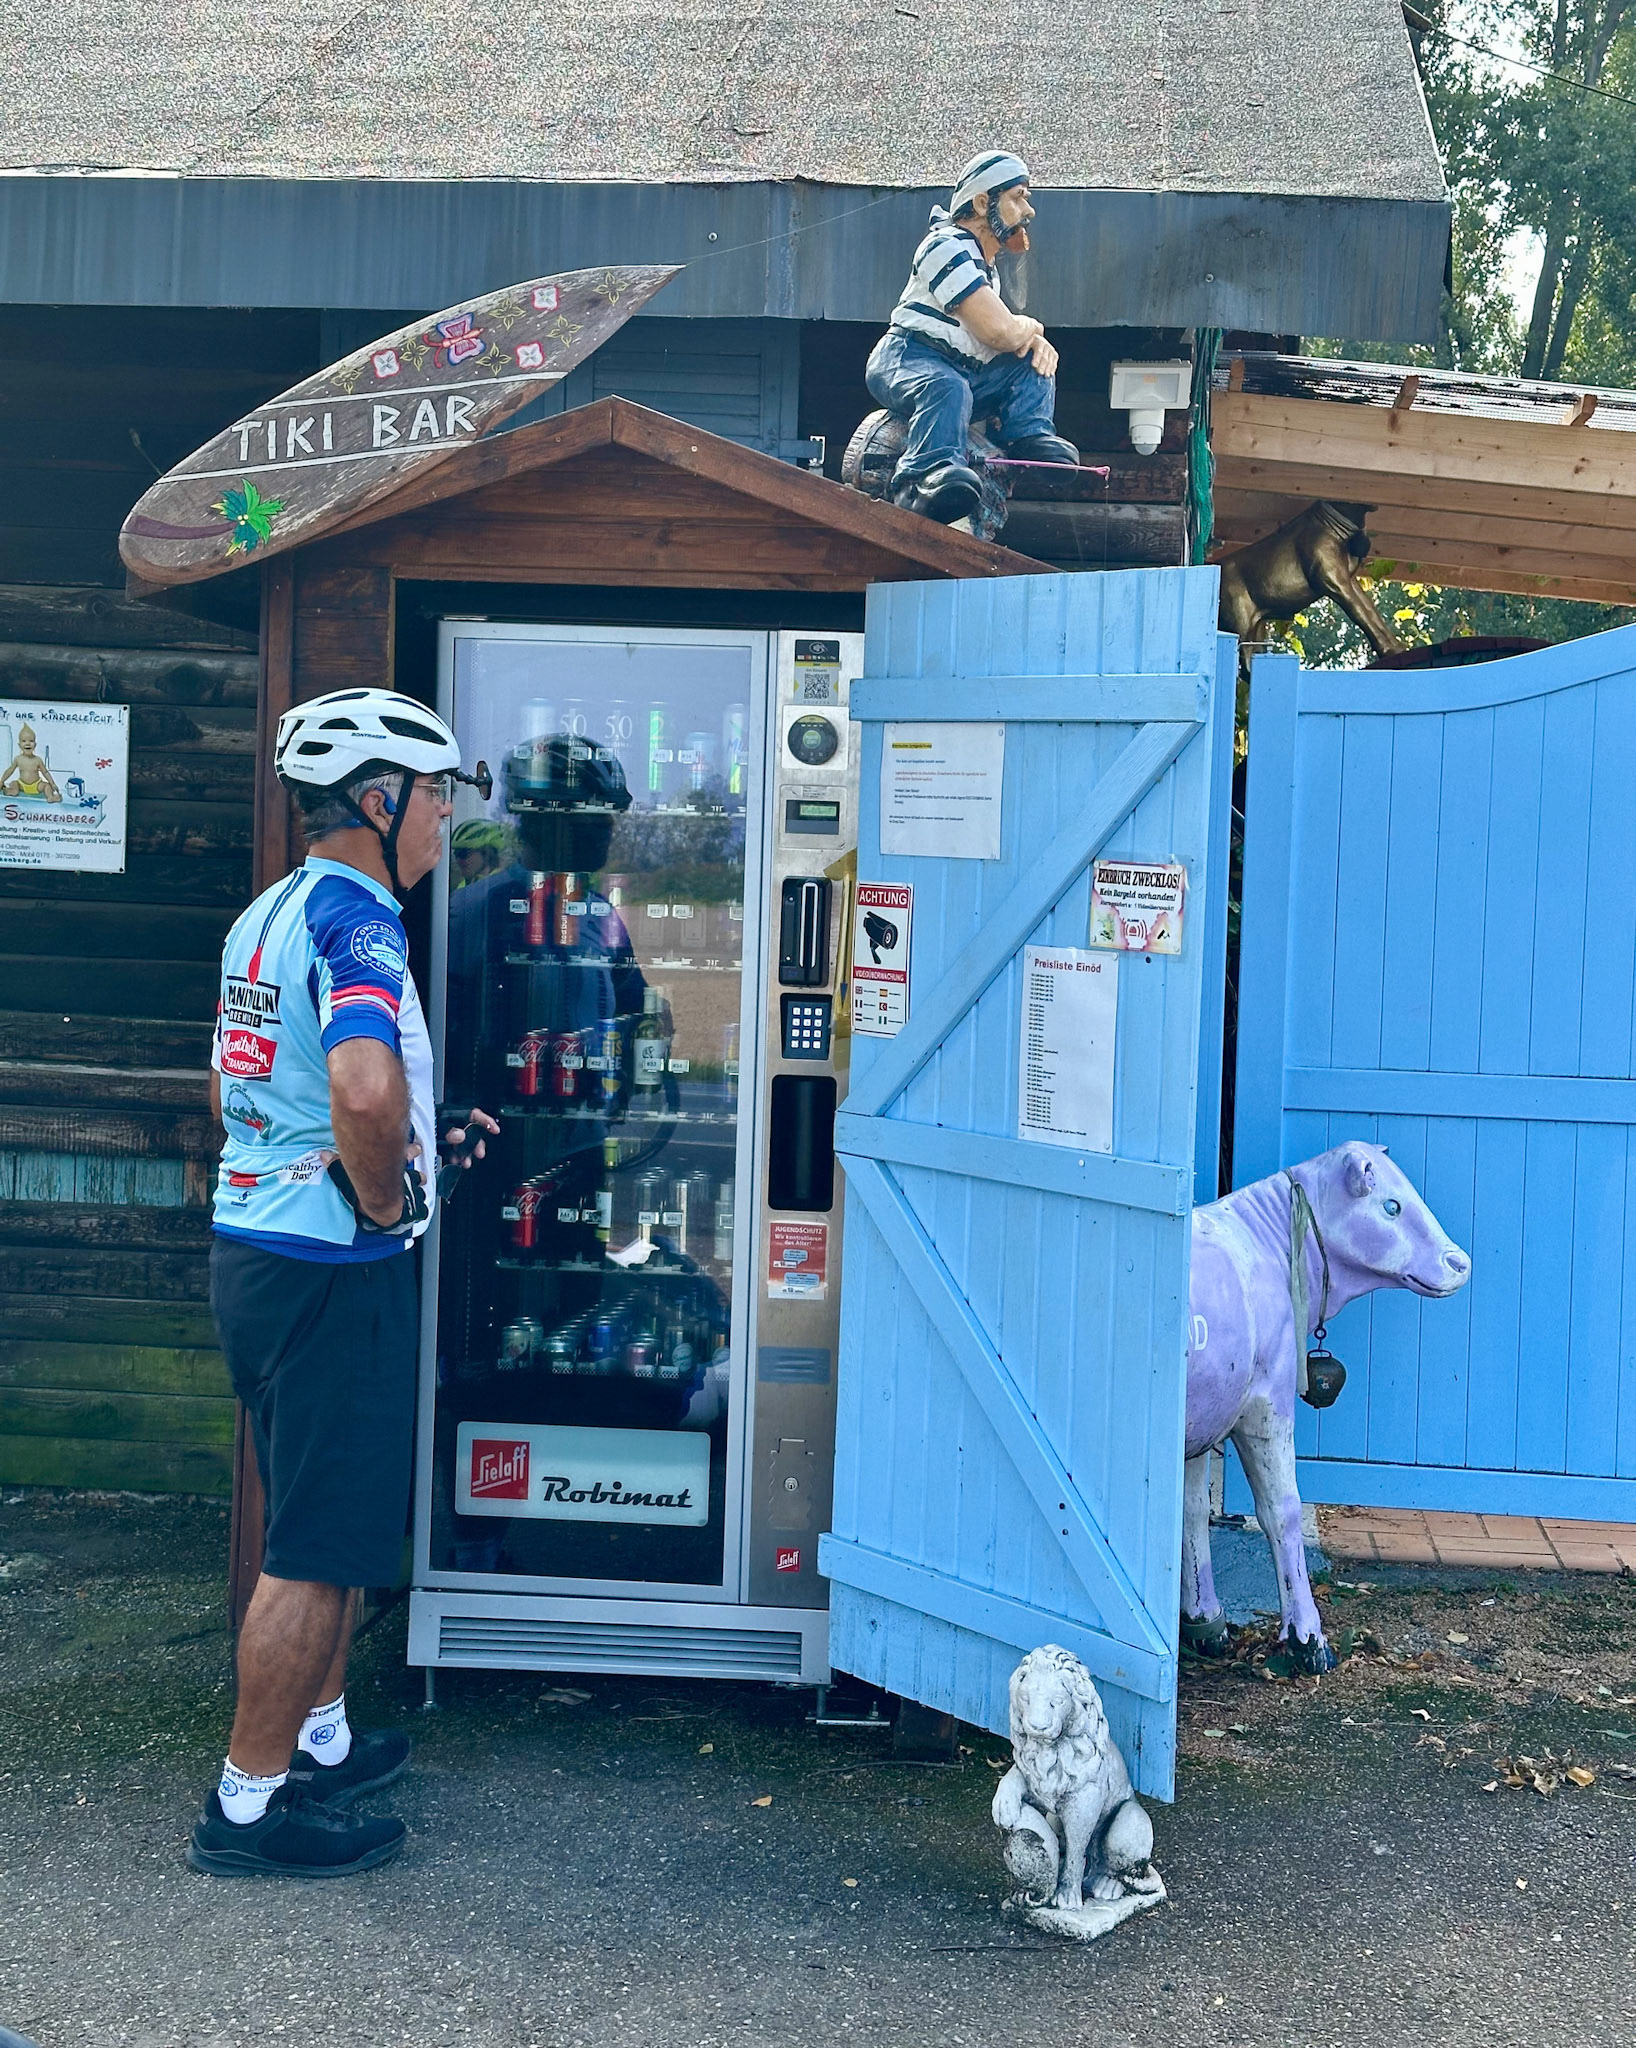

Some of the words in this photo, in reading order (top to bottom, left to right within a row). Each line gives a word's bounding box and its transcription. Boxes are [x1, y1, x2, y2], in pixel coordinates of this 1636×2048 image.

[231, 412, 334, 462] TIKI
[373, 395, 477, 448] BAR
[15, 711, 34, 719] UNS
[4, 804, 96, 826] SCHNAKENBERG
[1097, 868, 1131, 885] EINBRUCH
[1132, 871, 1181, 889] ZWECKLOS!
[859, 890, 908, 905] ACHTUNG
[1099, 888, 1113, 896] Kein
[1113, 889, 1136, 899] Bargeld
[1137, 892, 1177, 901] vorhanden!
[359, 925, 378, 936] OWEN
[1034, 958, 1074, 971] Preisliste
[1076, 961, 1102, 973] Einöd
[855, 969, 905, 981] VIDEOÜBERWACHUNG
[226, 1057, 261, 1073] TRANSPORT
[291, 1171, 312, 1181] Day!
[774, 1226, 823, 1234] JUGENDSCHUTZ
[786, 1234, 823, 1242] kontrollieren
[472, 1444, 528, 1493] Sielaff
[541, 1475, 694, 1509] Robimat
[777, 1550, 799, 1570] Sielaff
